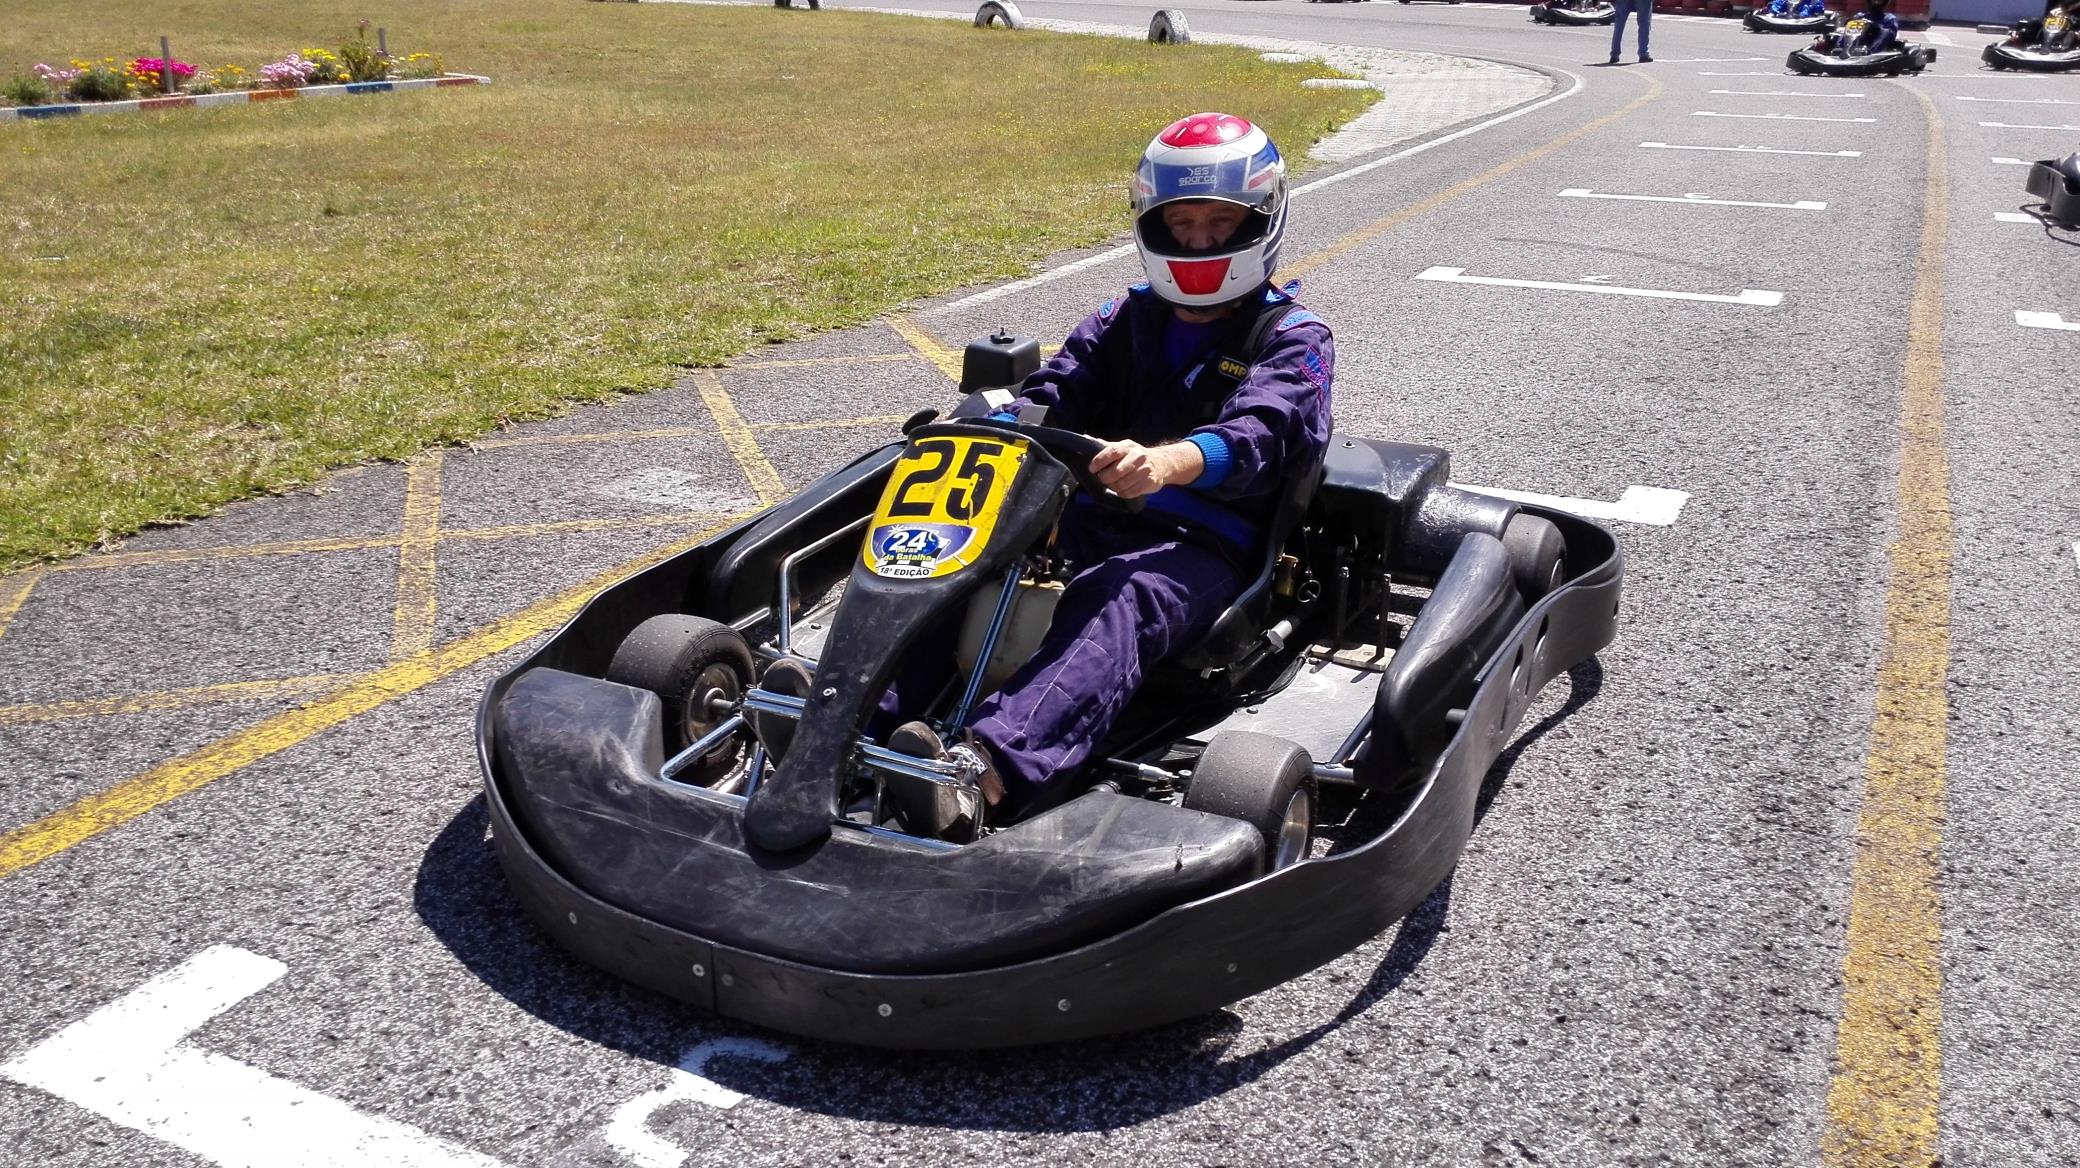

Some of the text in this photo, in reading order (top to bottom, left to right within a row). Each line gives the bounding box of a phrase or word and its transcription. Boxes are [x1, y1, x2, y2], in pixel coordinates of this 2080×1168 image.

[1178, 175, 1217, 185] sparco
[1221, 361, 1247, 377] OMP
[888, 439, 1004, 520] 25
[890, 531, 927, 552] 24
[896, 553, 932, 561] Batalha
[894, 568, 930, 577] EDIÇÃO
